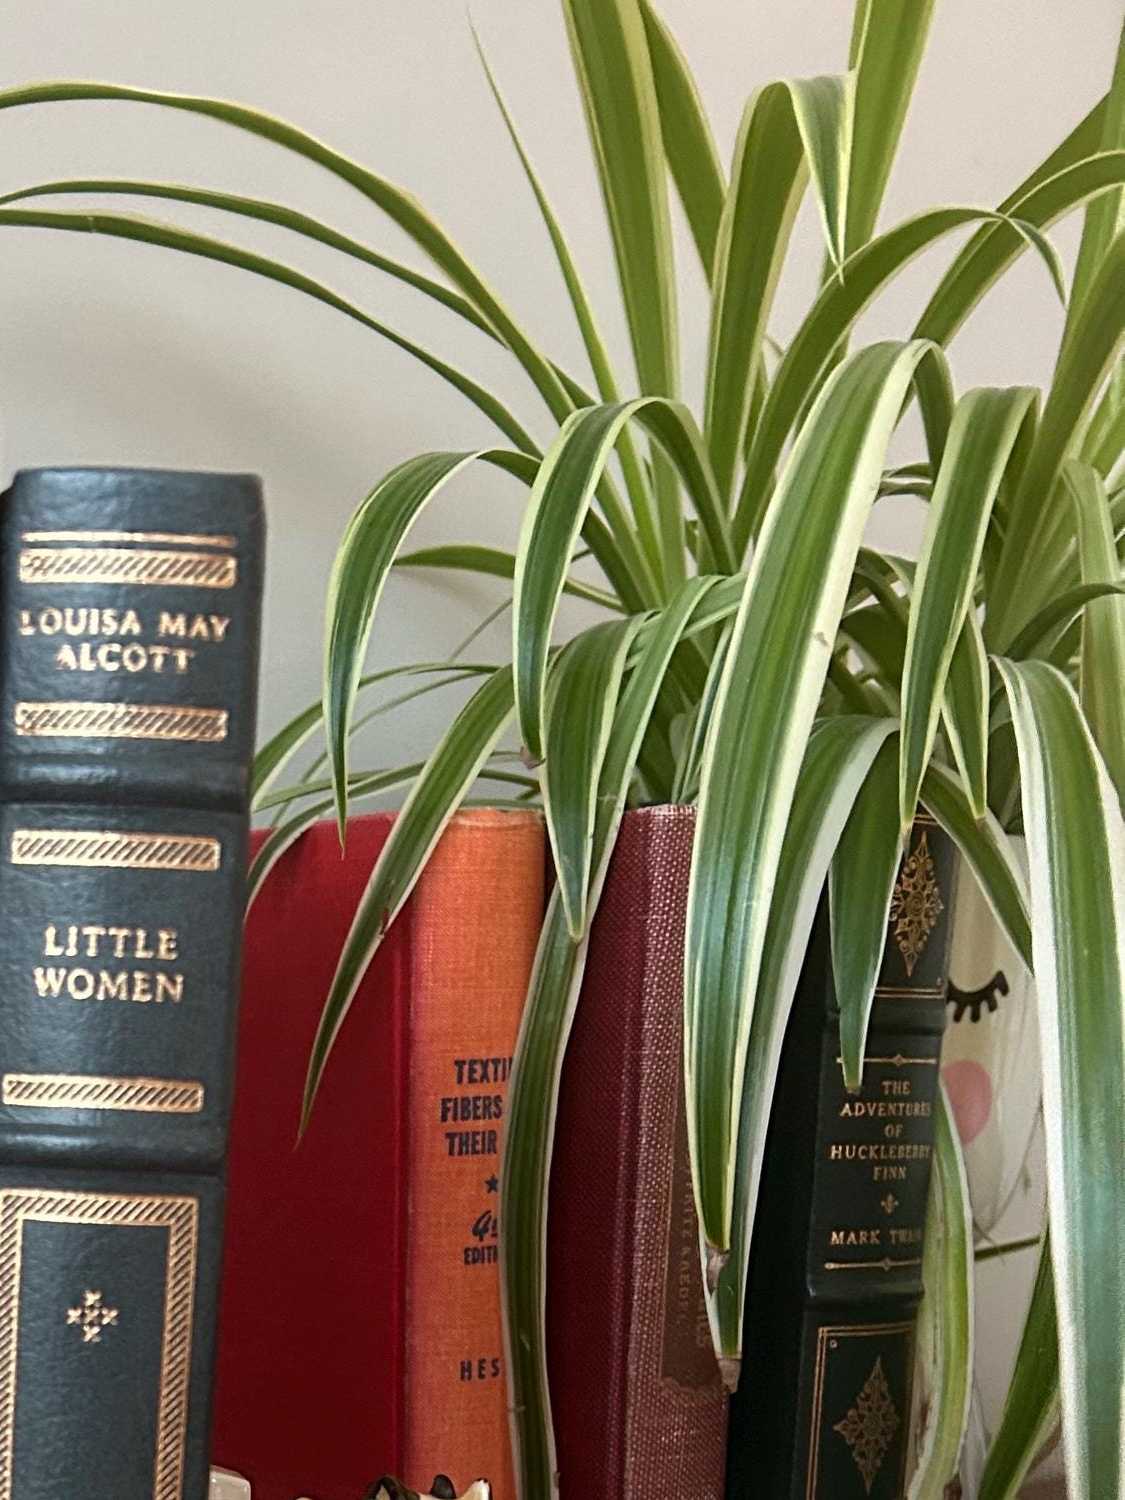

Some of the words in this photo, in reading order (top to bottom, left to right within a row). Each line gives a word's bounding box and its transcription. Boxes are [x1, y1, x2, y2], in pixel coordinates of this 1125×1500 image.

[19, 607, 142, 637] LOUISA
[158, 612, 231, 642] MAY
[55, 642, 196, 675] ALCOTT
[43, 923, 180, 961] LITTLE
[32, 966, 185, 1005] WOMEN
[883, 1080, 910, 1096] THE
[440, 1095, 503, 1123] FIBERS
[445, 1130, 497, 1157] THEIR
[884, 1123, 904, 1139] OF
[873, 1165, 908, 1181] FINN
[830, 1230, 880, 1246] MARK
